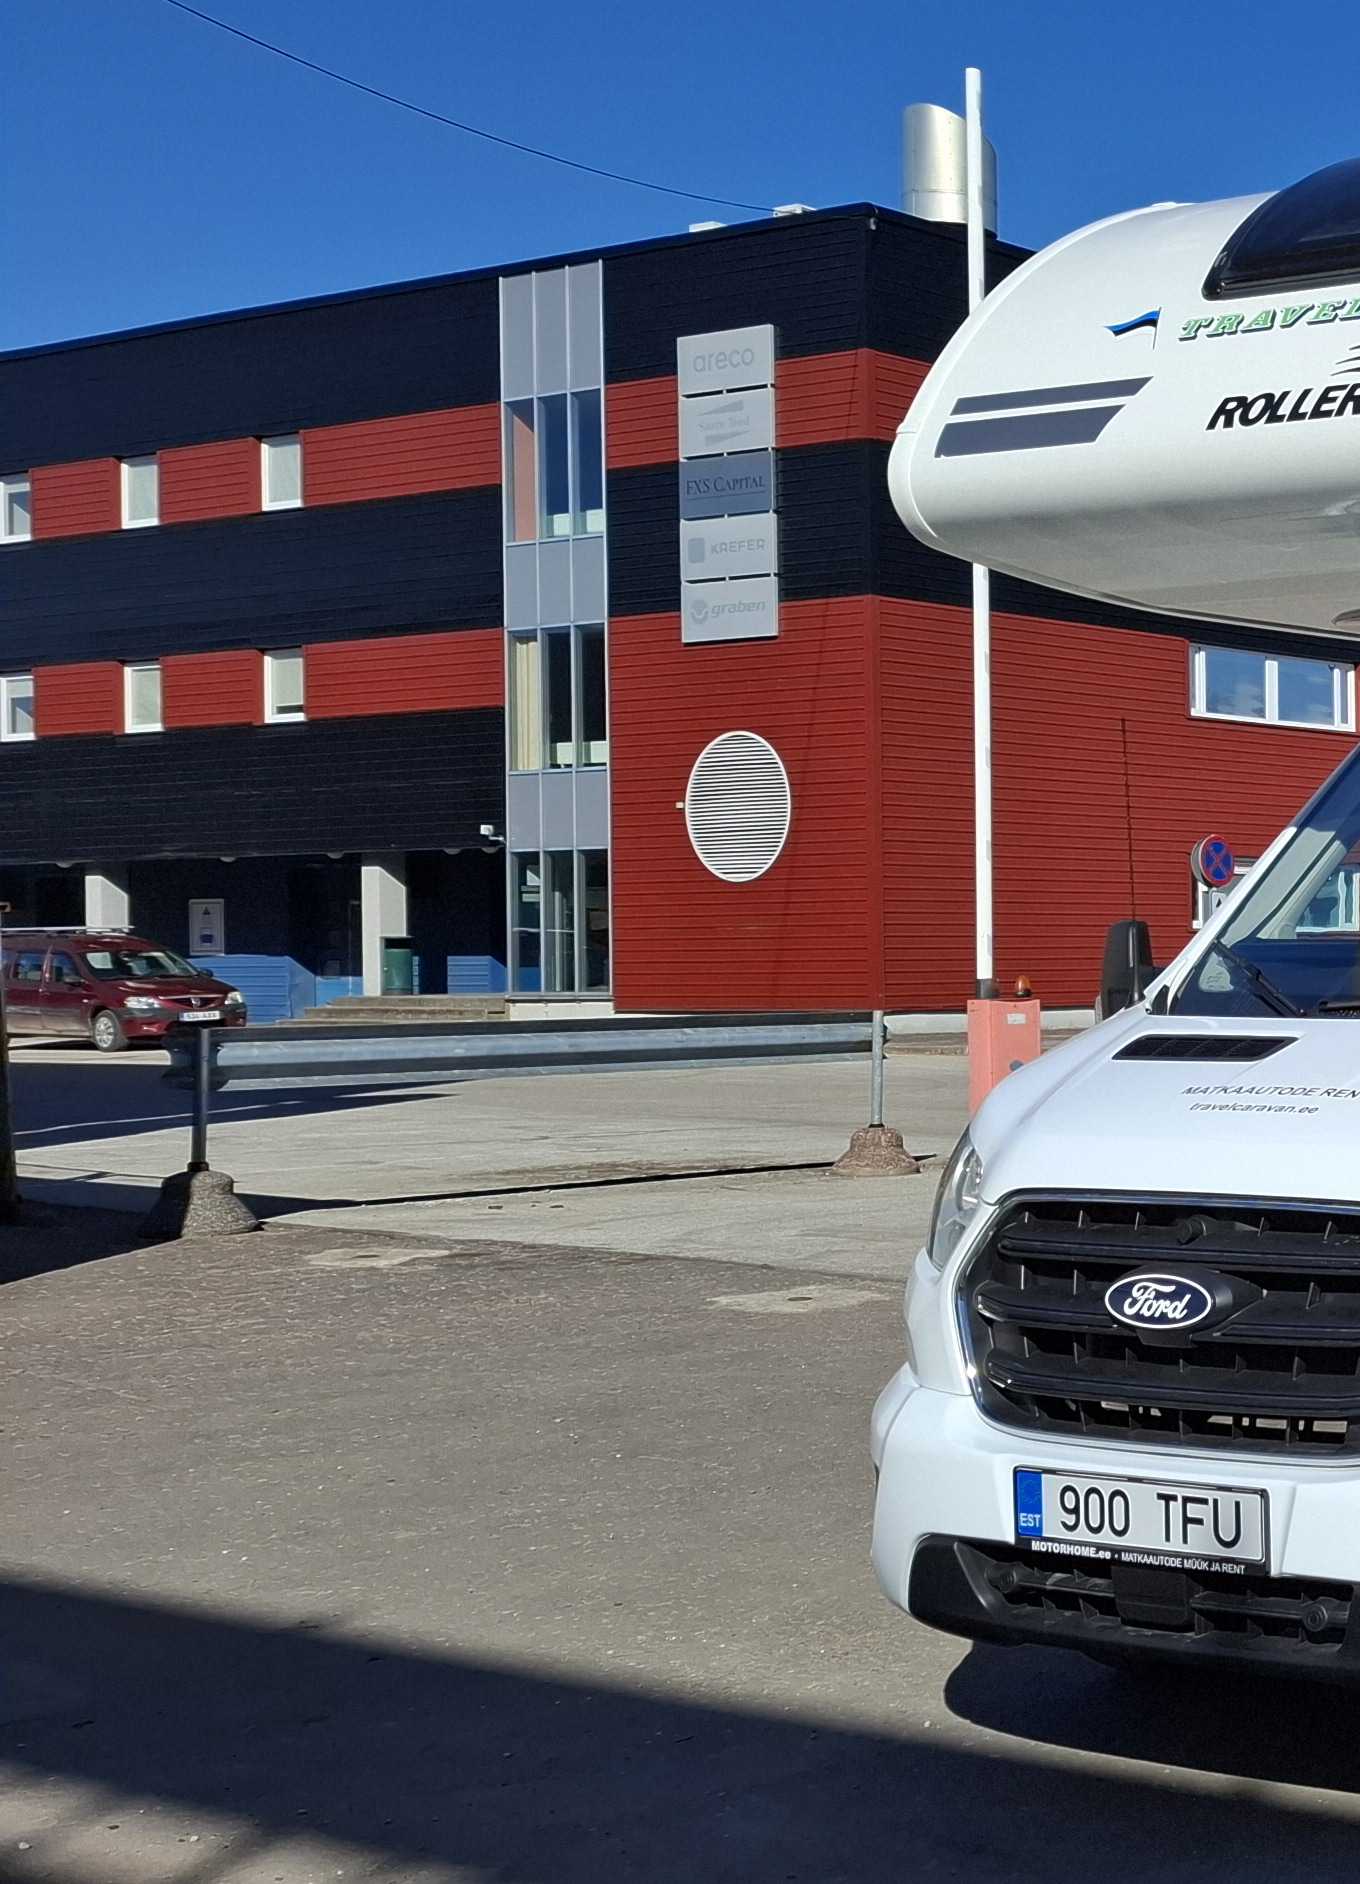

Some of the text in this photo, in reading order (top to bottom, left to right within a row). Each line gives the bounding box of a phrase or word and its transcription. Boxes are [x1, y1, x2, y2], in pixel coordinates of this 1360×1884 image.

[692, 348, 754, 373] areco
[711, 600, 766, 618] graben
[1181, 1085, 1320, 1097] MATKAAUTODE
[1189, 1102, 1320, 1114] travelcaravan.ee
[1123, 1281, 1192, 1319] Ford
[1019, 1512, 1041, 1528] EST
[1059, 1484, 1242, 1549] 900 TFU
[1121, 1552, 1183, 1569] MATKAAUTODE
[1183, 1555, 1209, 1571] MÜÜK
[1209, 1561, 1221, 1572] JA
[1221, 1562, 1246, 1575] RENT
